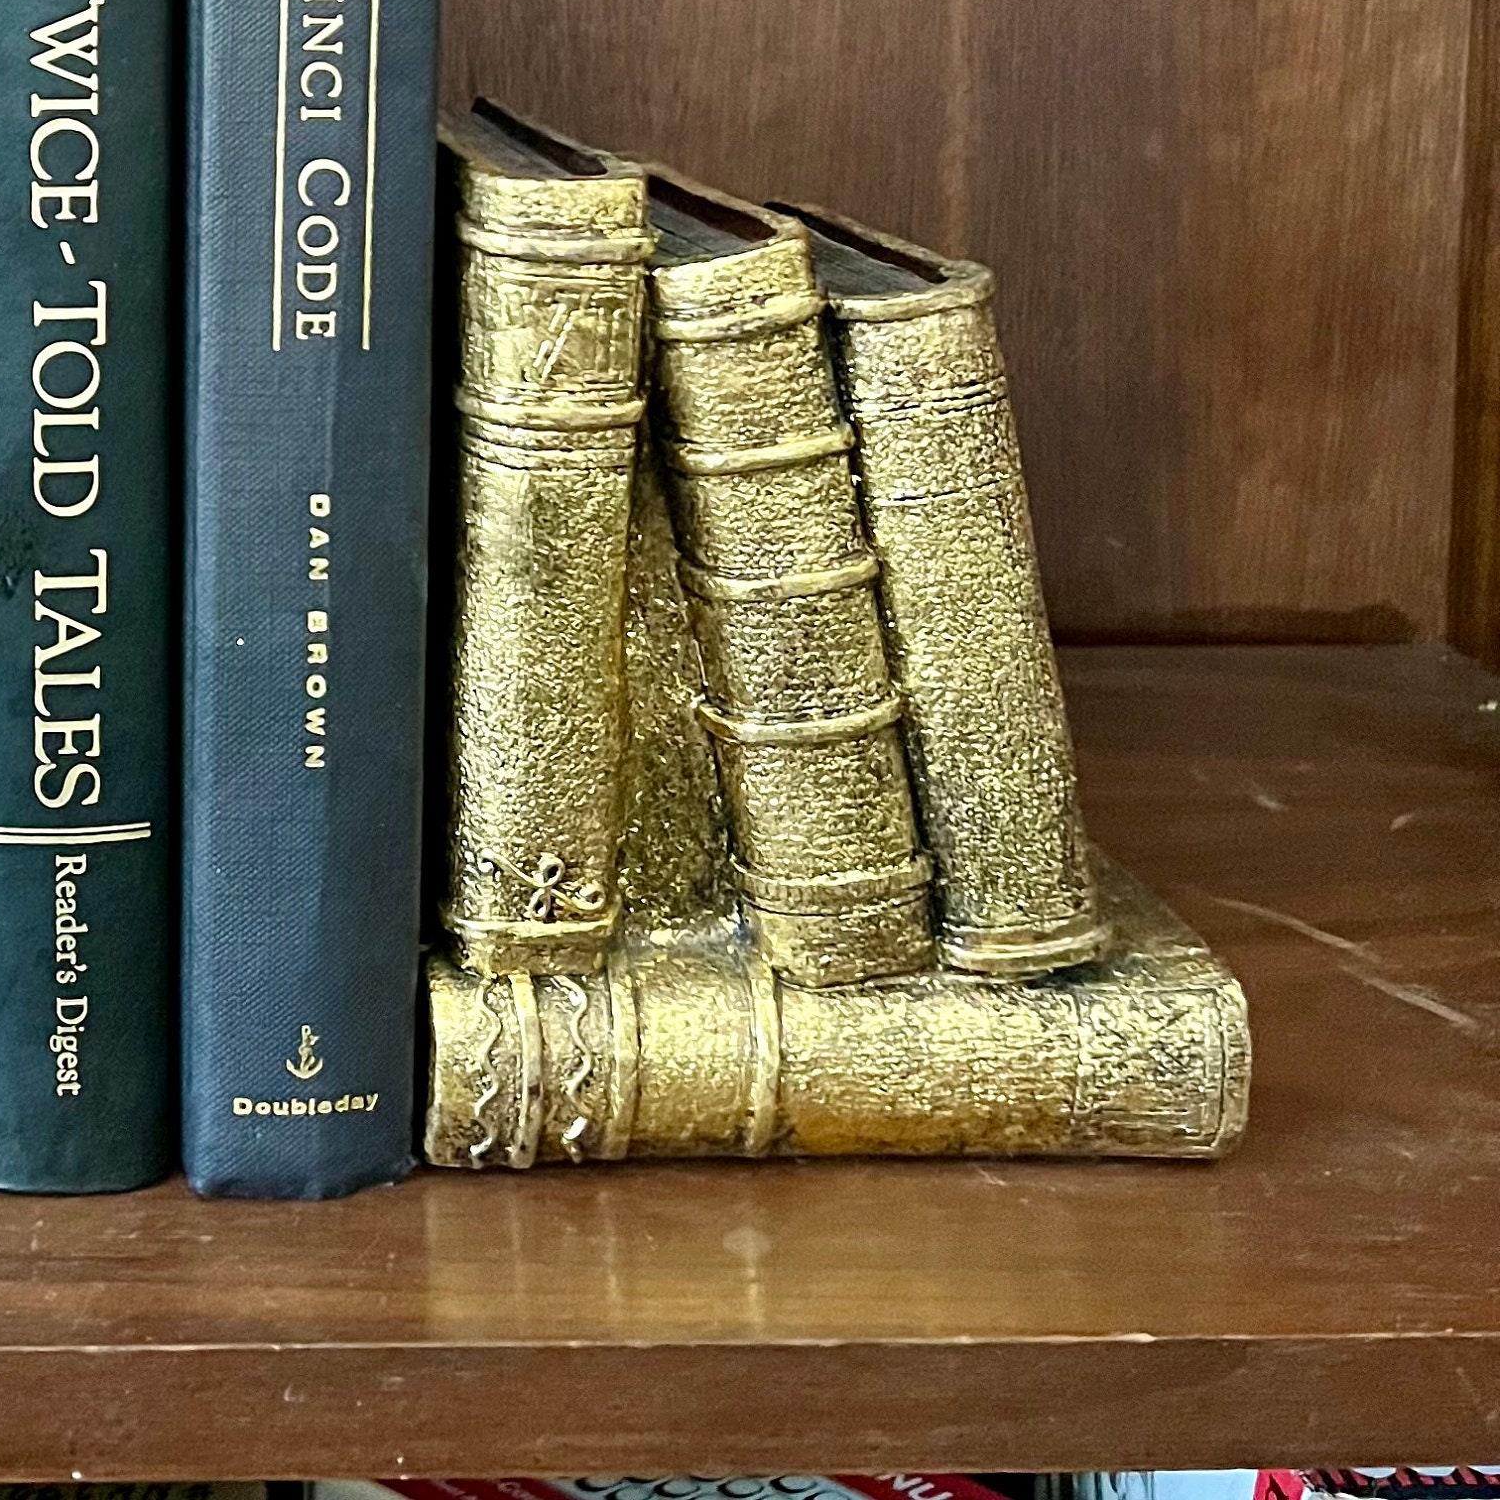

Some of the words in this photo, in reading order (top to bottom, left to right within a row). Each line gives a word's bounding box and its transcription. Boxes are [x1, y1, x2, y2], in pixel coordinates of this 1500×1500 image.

[295, 158, 351, 341] CODE
[308, 493, 331, 580] DAN
[34, 548, 107, 808] TALES
[304, 610, 329, 768] BROWN
[55, 853, 89, 984] Reader's
[49, 995, 88, 1097] Digest
[233, 1093, 379, 1116] Doubleday
